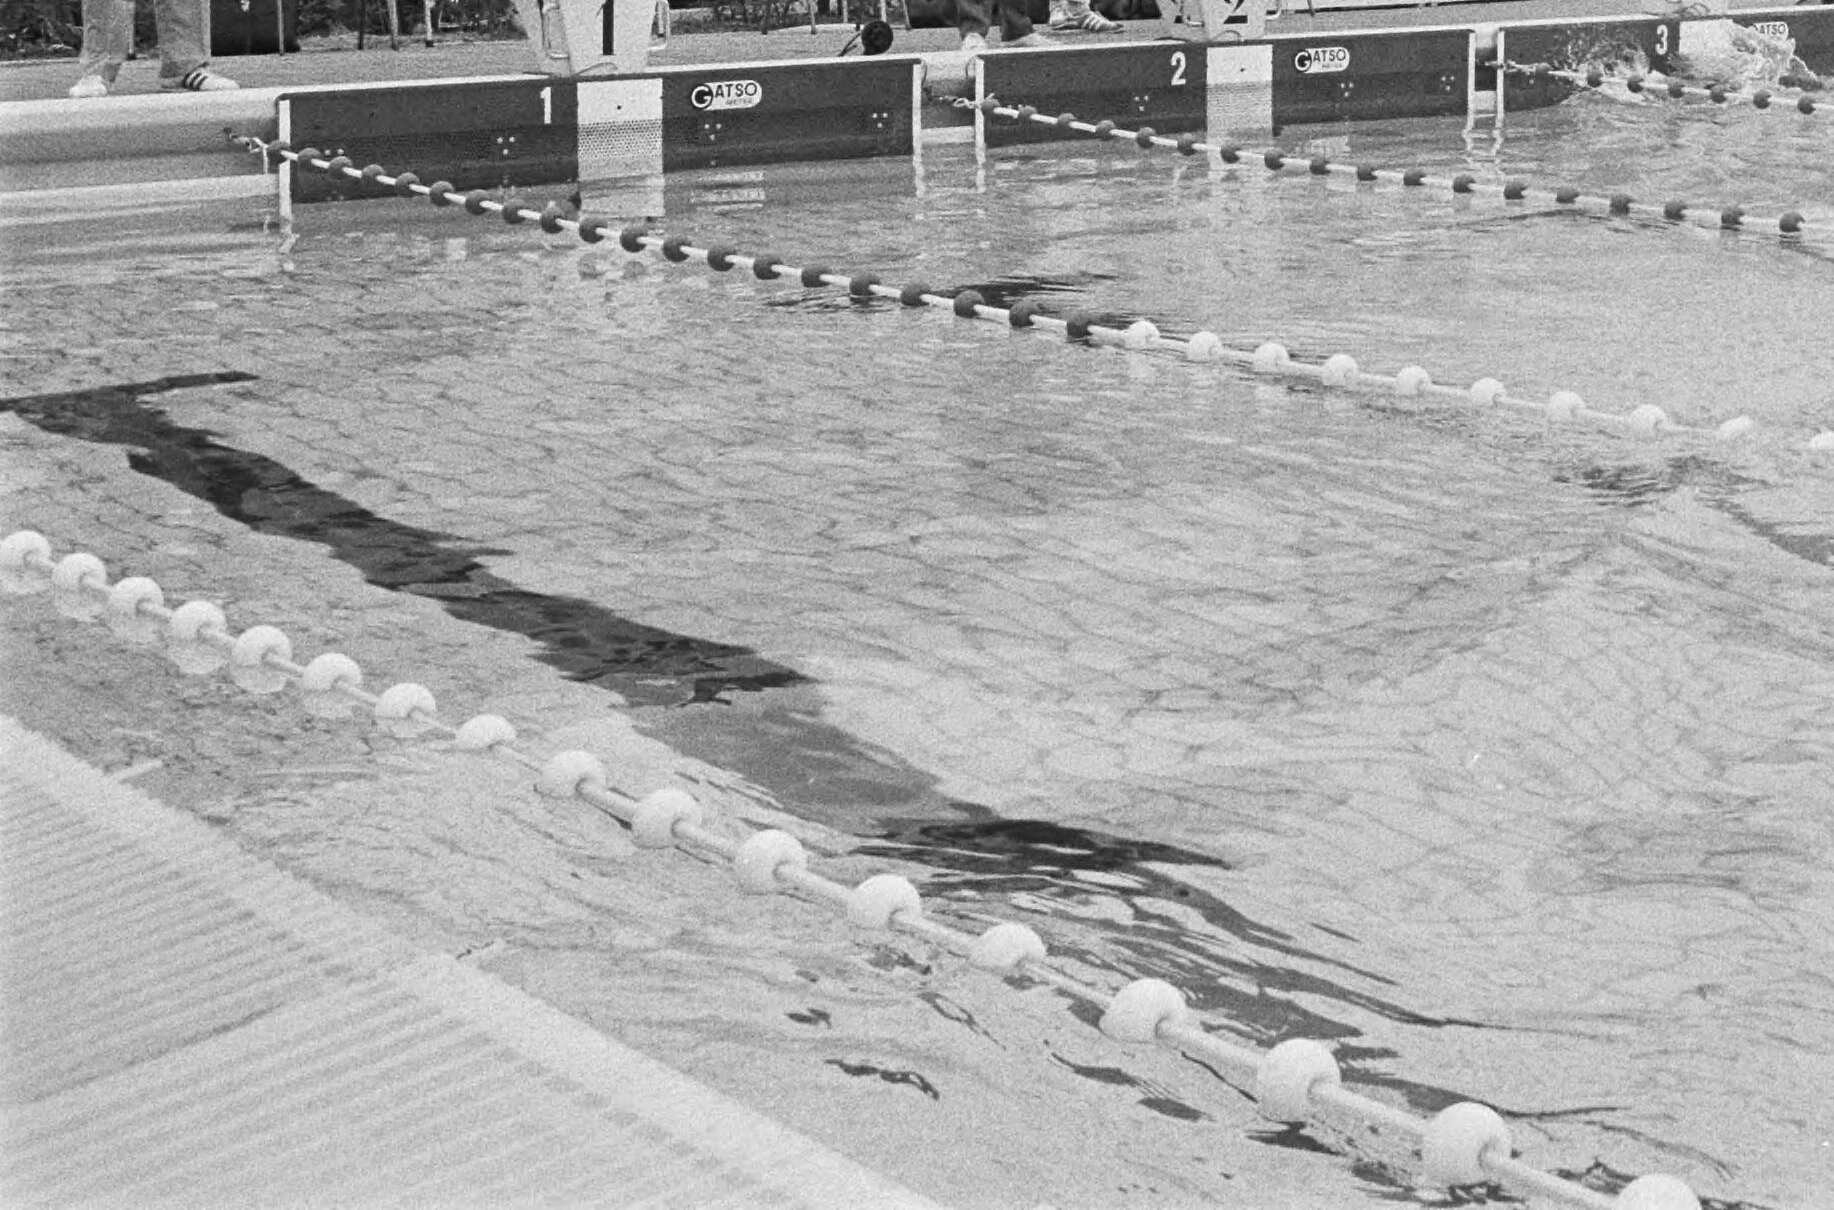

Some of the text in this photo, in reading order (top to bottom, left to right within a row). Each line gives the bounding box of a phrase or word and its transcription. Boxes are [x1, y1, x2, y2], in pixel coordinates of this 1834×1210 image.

[1655, 24, 1668, 56] 3
[1171, 51, 1186, 86] 2
[1294, 48, 1346, 72] GATSO
[540, 87, 552, 125] 1
[690, 82, 758, 109] GATSO
